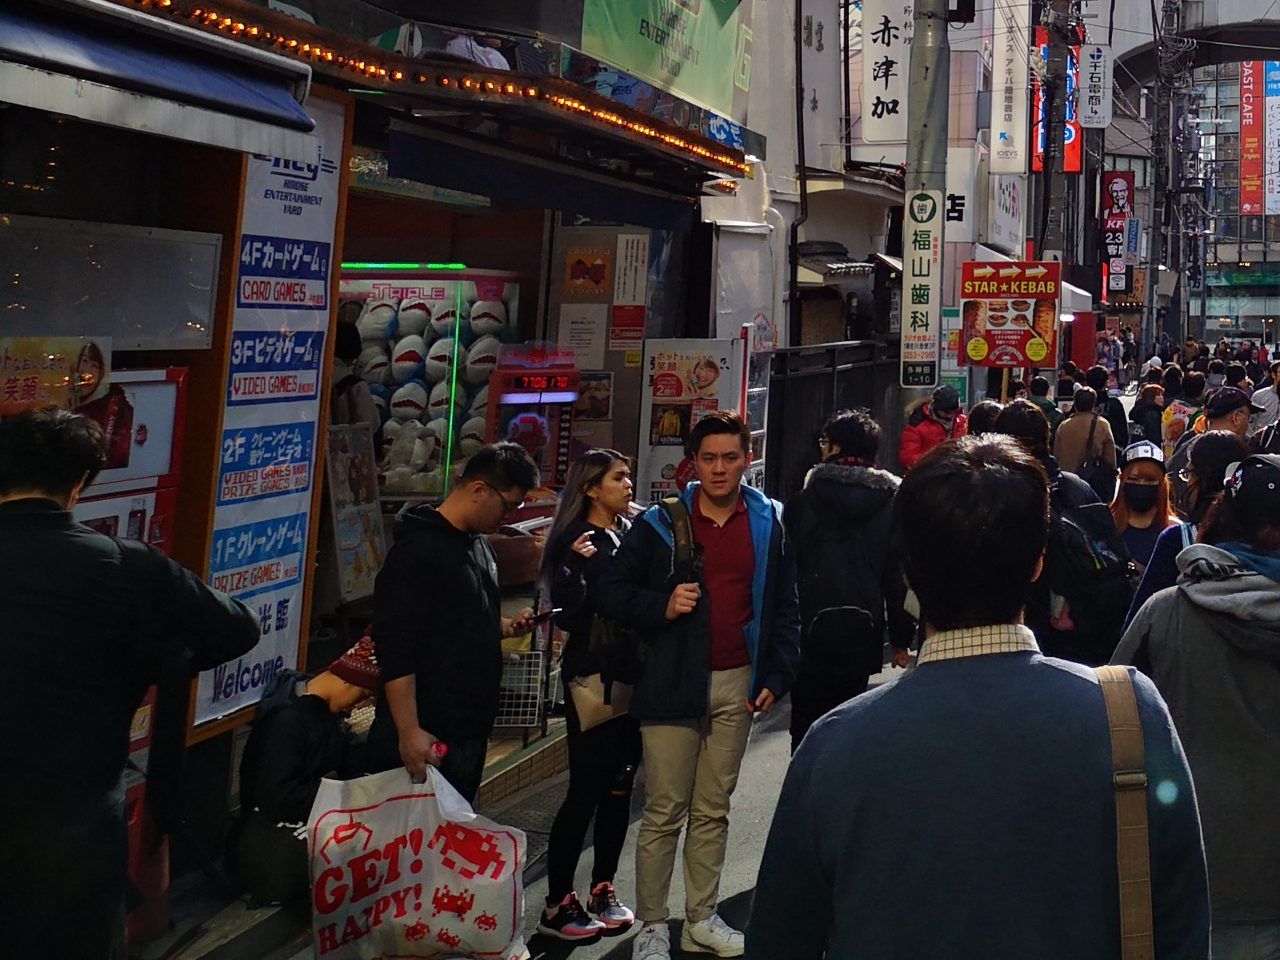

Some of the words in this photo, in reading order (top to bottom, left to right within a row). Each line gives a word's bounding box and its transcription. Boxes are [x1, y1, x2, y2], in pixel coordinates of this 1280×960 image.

[870, 14, 901, 119] 赤津加
[1242, 96, 1253, 125] CAFE
[242, 280, 271, 302] CARD
[273, 282, 307, 302] GAMES
[910, 229, 932, 333] 福山歯科
[965, 281, 998, 294] STAR
[1010, 280, 1056, 294] KEBAB
[233, 377, 267, 396] VIDEO
[268, 375, 298, 394] GAMES
[223, 469, 258, 486] VIDEO
[260, 463, 291, 481] GAMES
[221, 482, 258, 499] PRIZE
[212, 655, 284, 704] Welcome
[313, 828, 424, 916] GET!
[317, 883, 424, 947] HAPPY!
